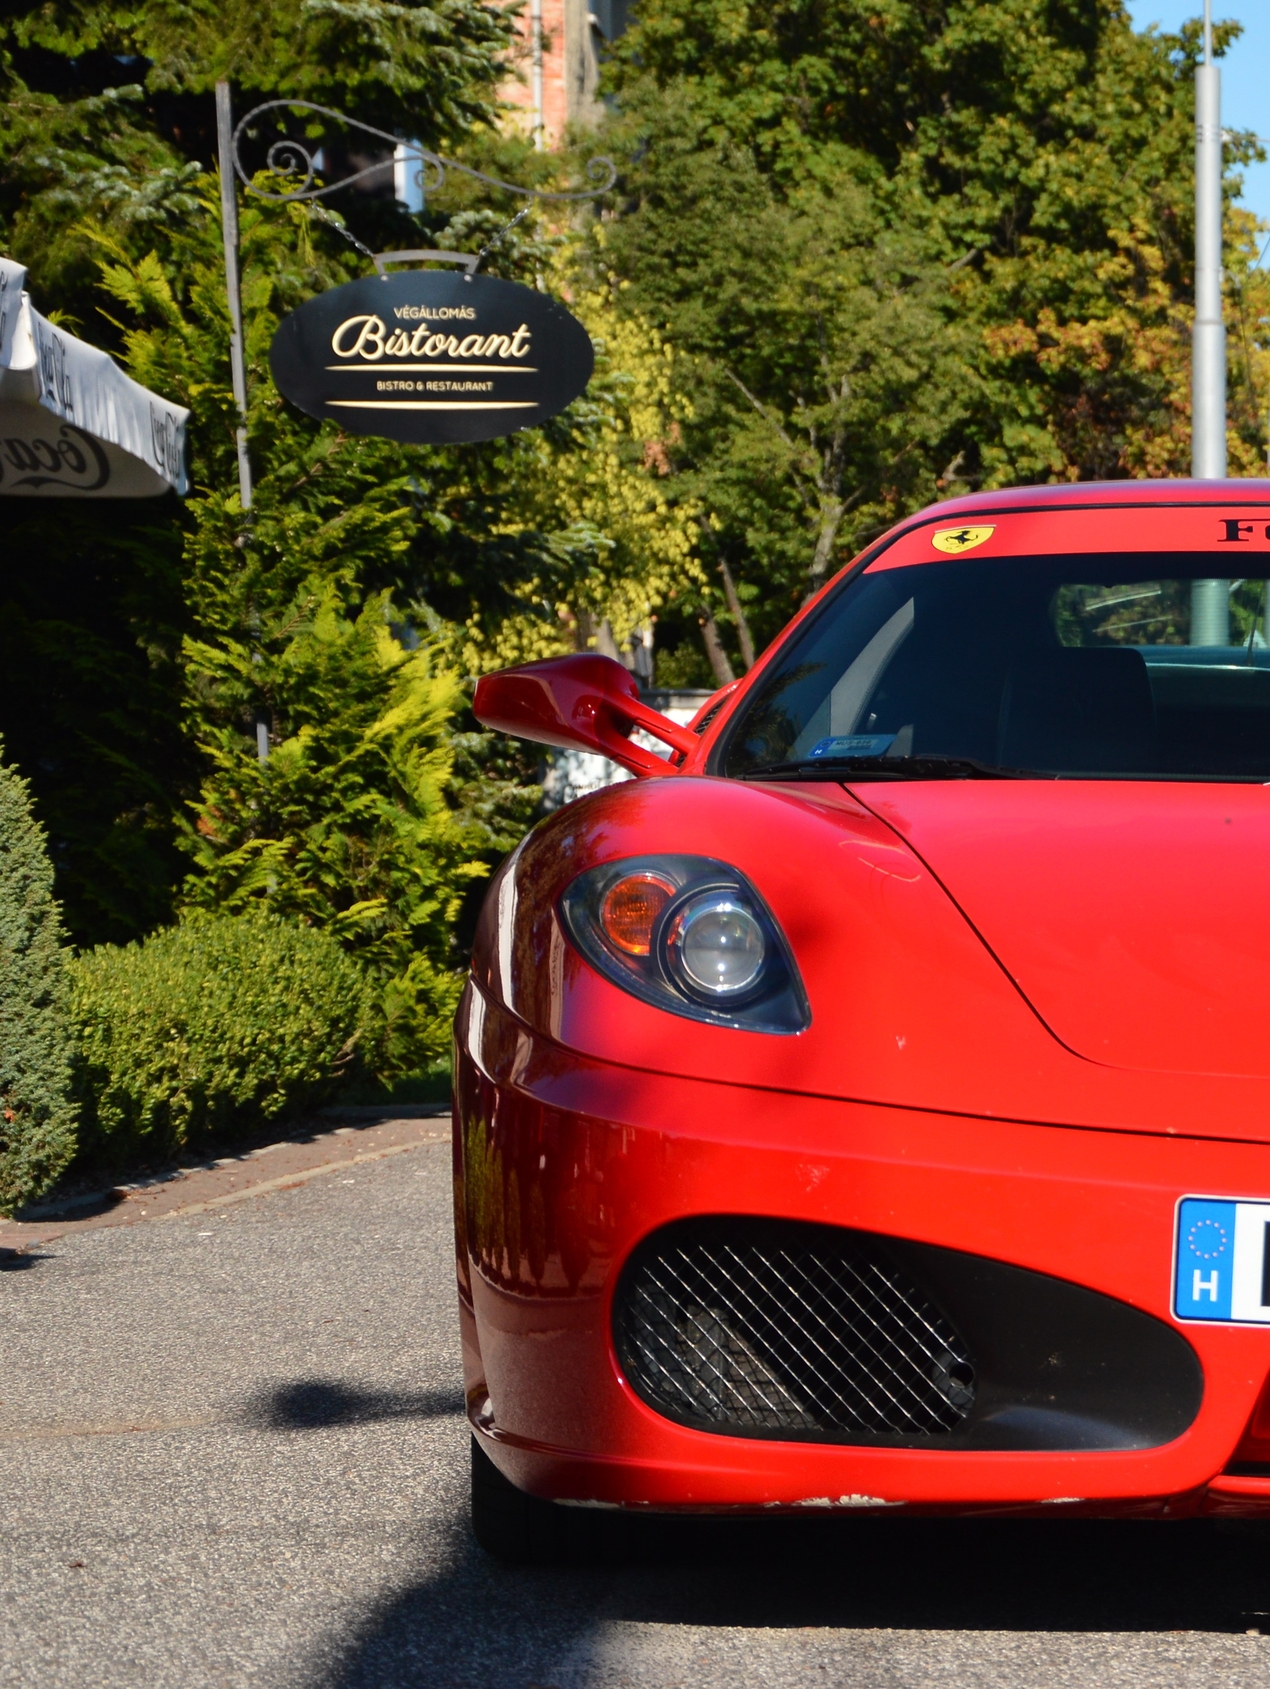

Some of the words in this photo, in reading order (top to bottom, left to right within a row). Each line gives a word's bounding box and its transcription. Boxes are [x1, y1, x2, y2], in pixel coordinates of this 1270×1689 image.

[393, 304, 476, 321] VÉGÁLLOMÁS
[331, 314, 532, 361] Bistorant
[376, 380, 415, 392] BISTRO
[416, 380, 425, 392] &
[426, 380, 494, 392] RESTAURANT
[1193, 1269, 1218, 1302] H
